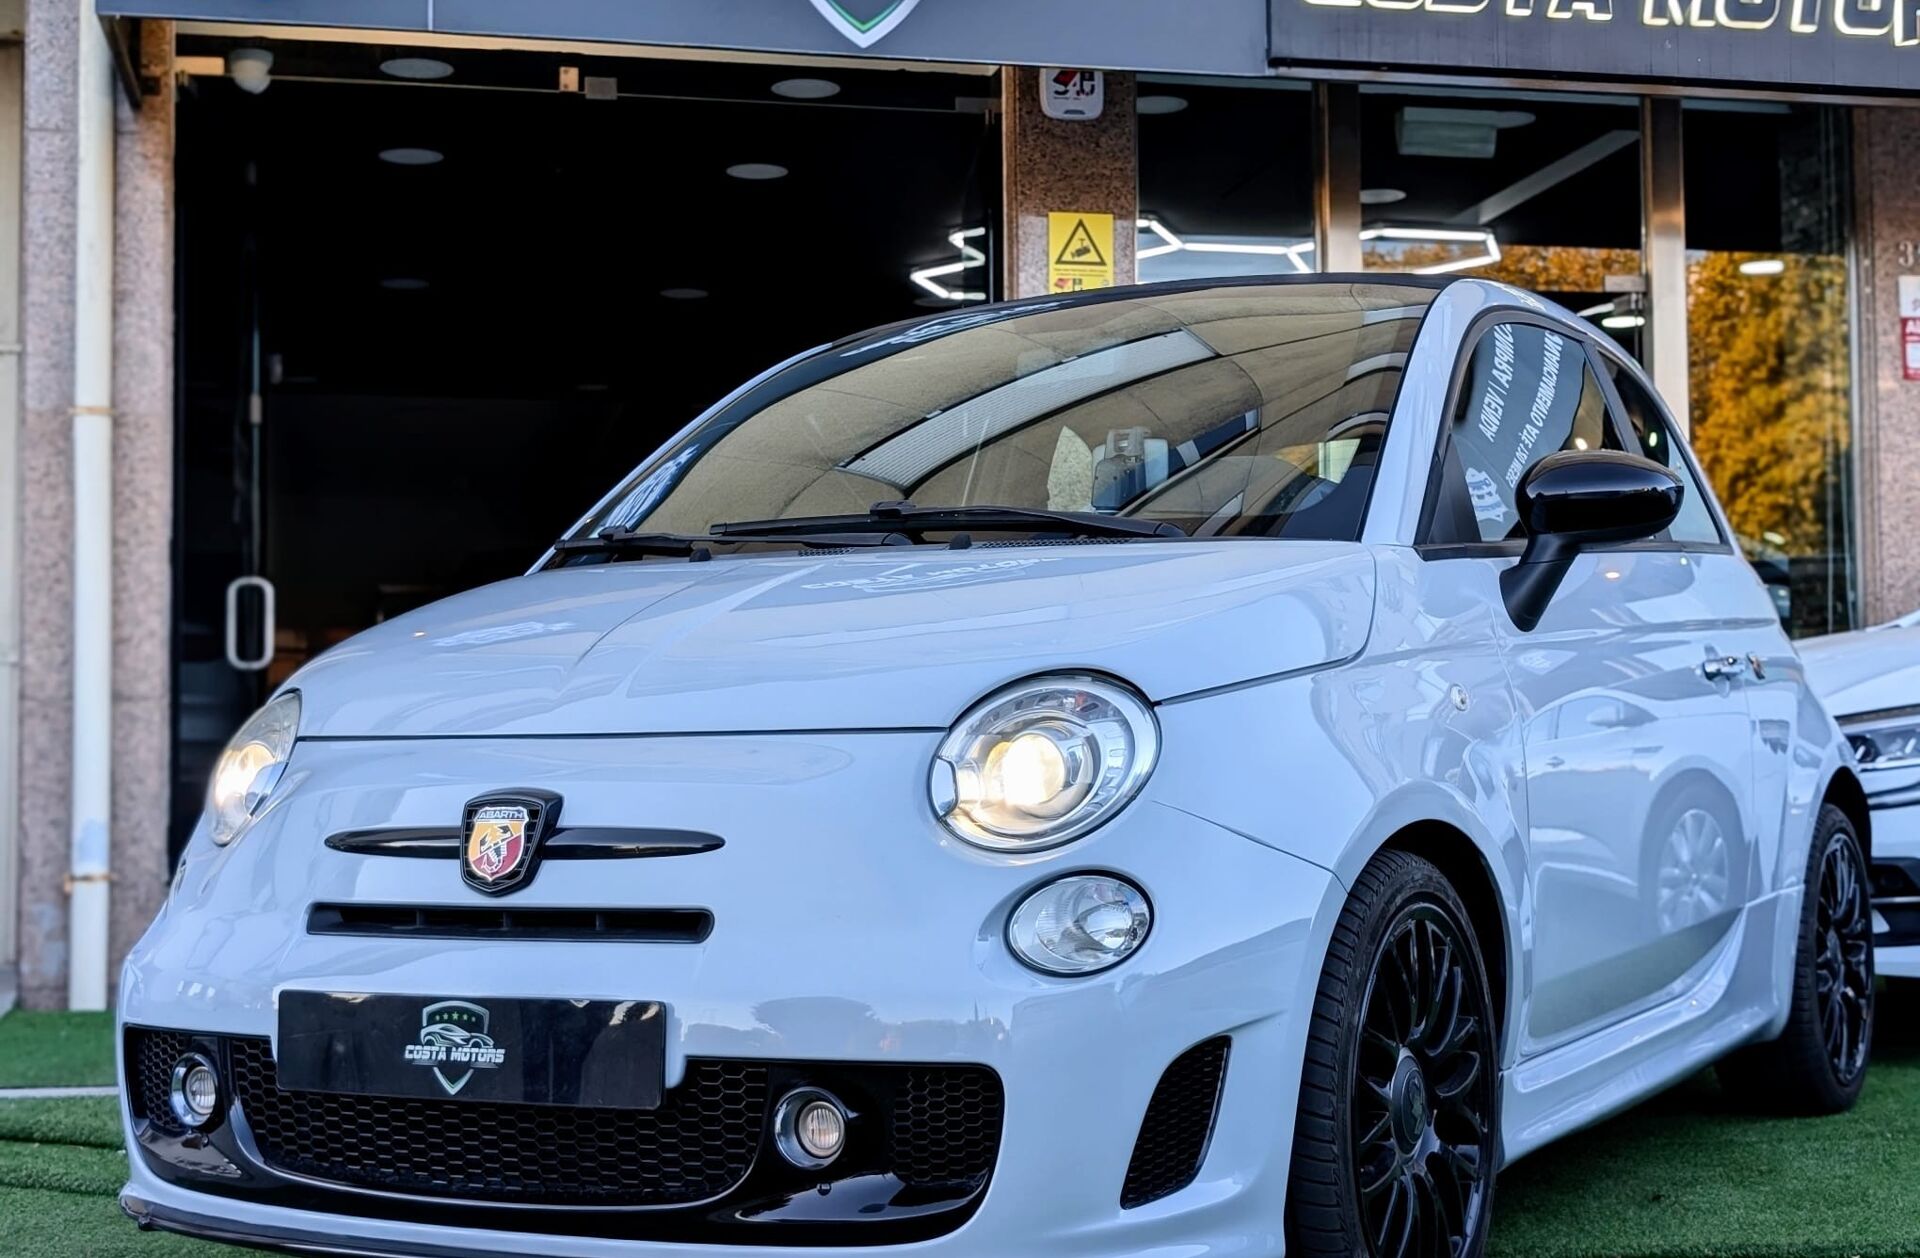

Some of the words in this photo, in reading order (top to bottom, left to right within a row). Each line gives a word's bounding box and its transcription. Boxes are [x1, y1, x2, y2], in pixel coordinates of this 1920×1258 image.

[479, 810, 523, 819] ABARTH
[404, 1045, 447, 1061] COSTA
[450, 1047, 506, 1063] MOTORS
